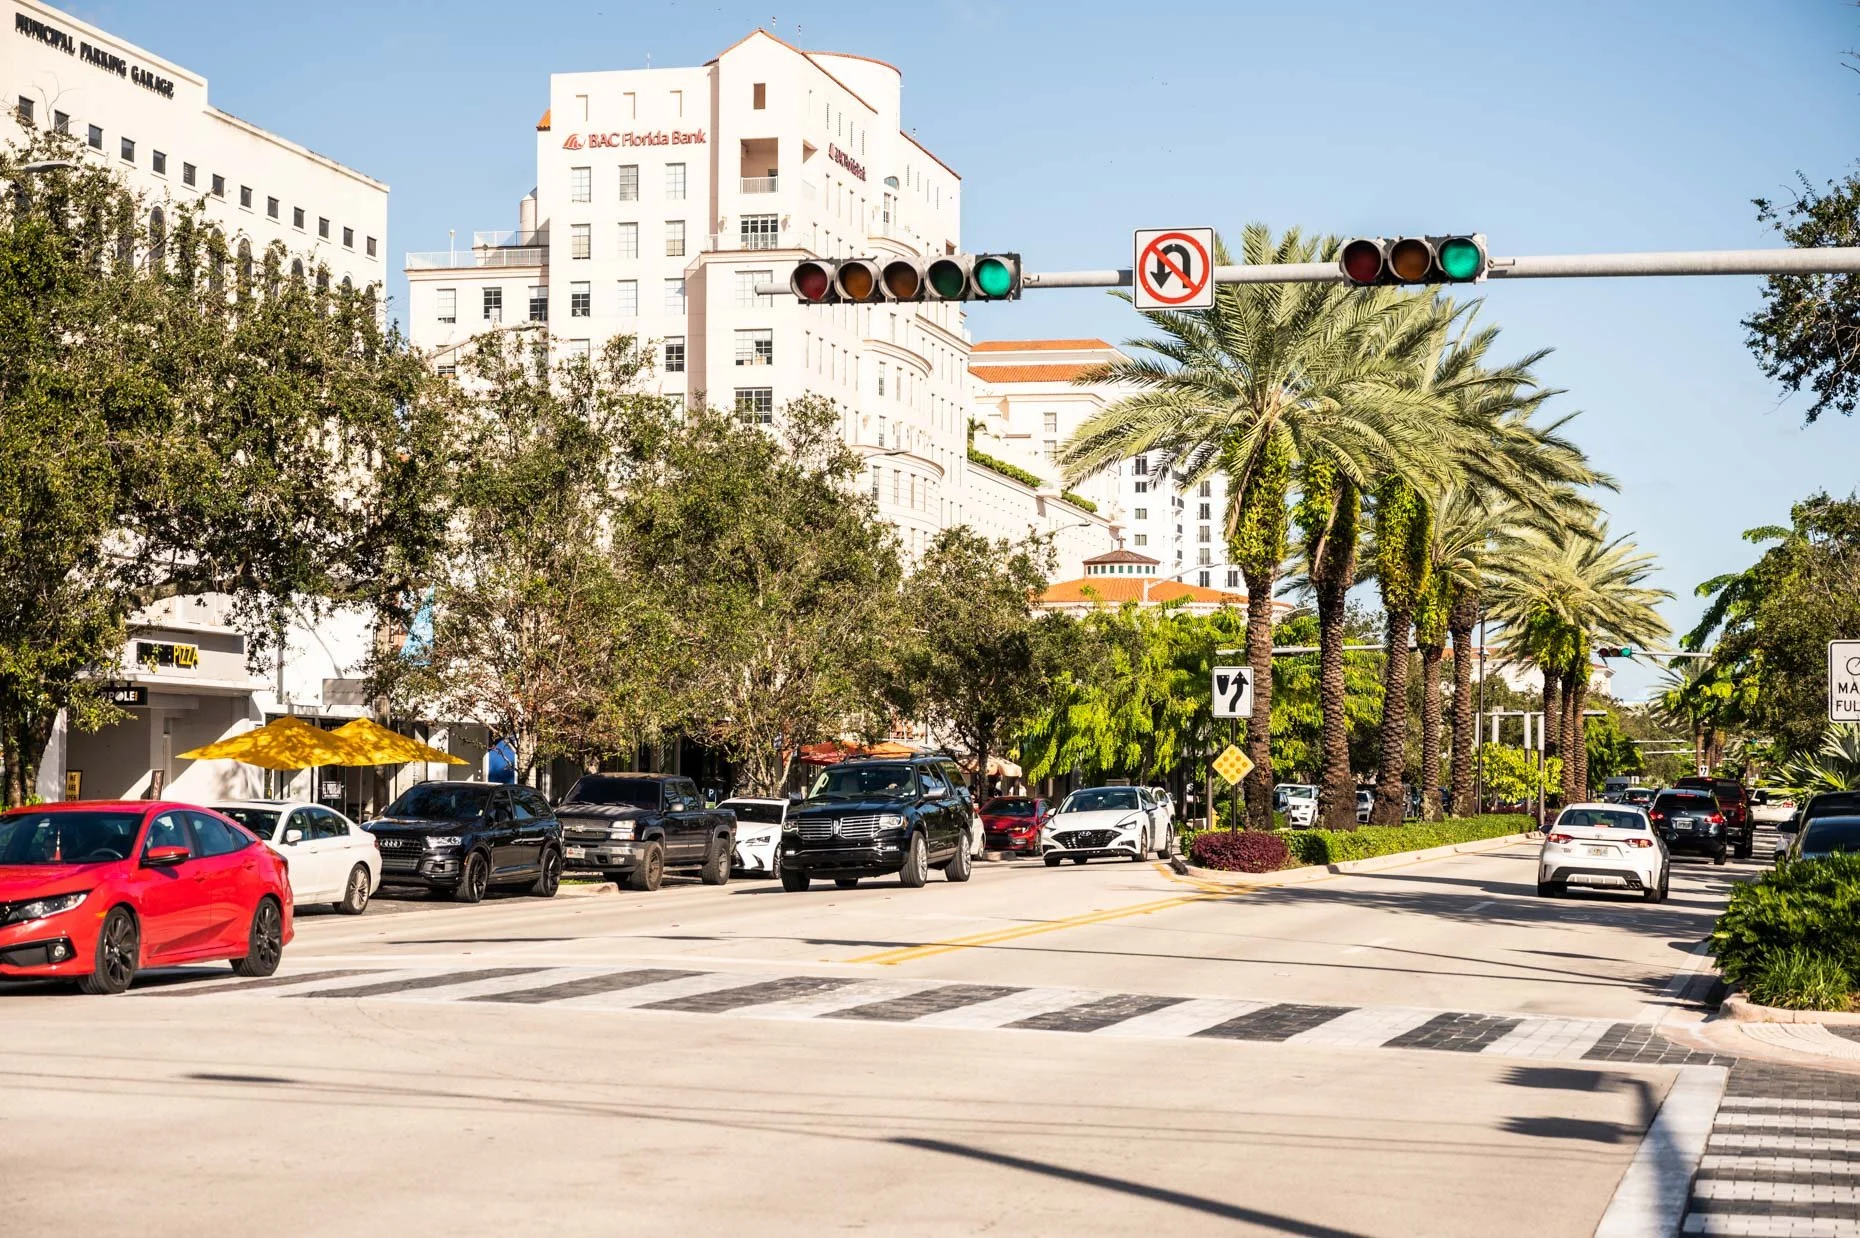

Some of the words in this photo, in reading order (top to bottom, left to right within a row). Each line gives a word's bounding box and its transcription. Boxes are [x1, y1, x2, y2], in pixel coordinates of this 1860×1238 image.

[15, 12, 76, 56] MUNICIPAL
[80, 41, 127, 79] PARKING
[131, 65, 175, 100] GARAGE
[588, 132, 620, 148] BAC
[622, 130, 669, 147] Florida
[671, 128, 707, 145] Bank
[173, 644, 199, 667] PIZZA
